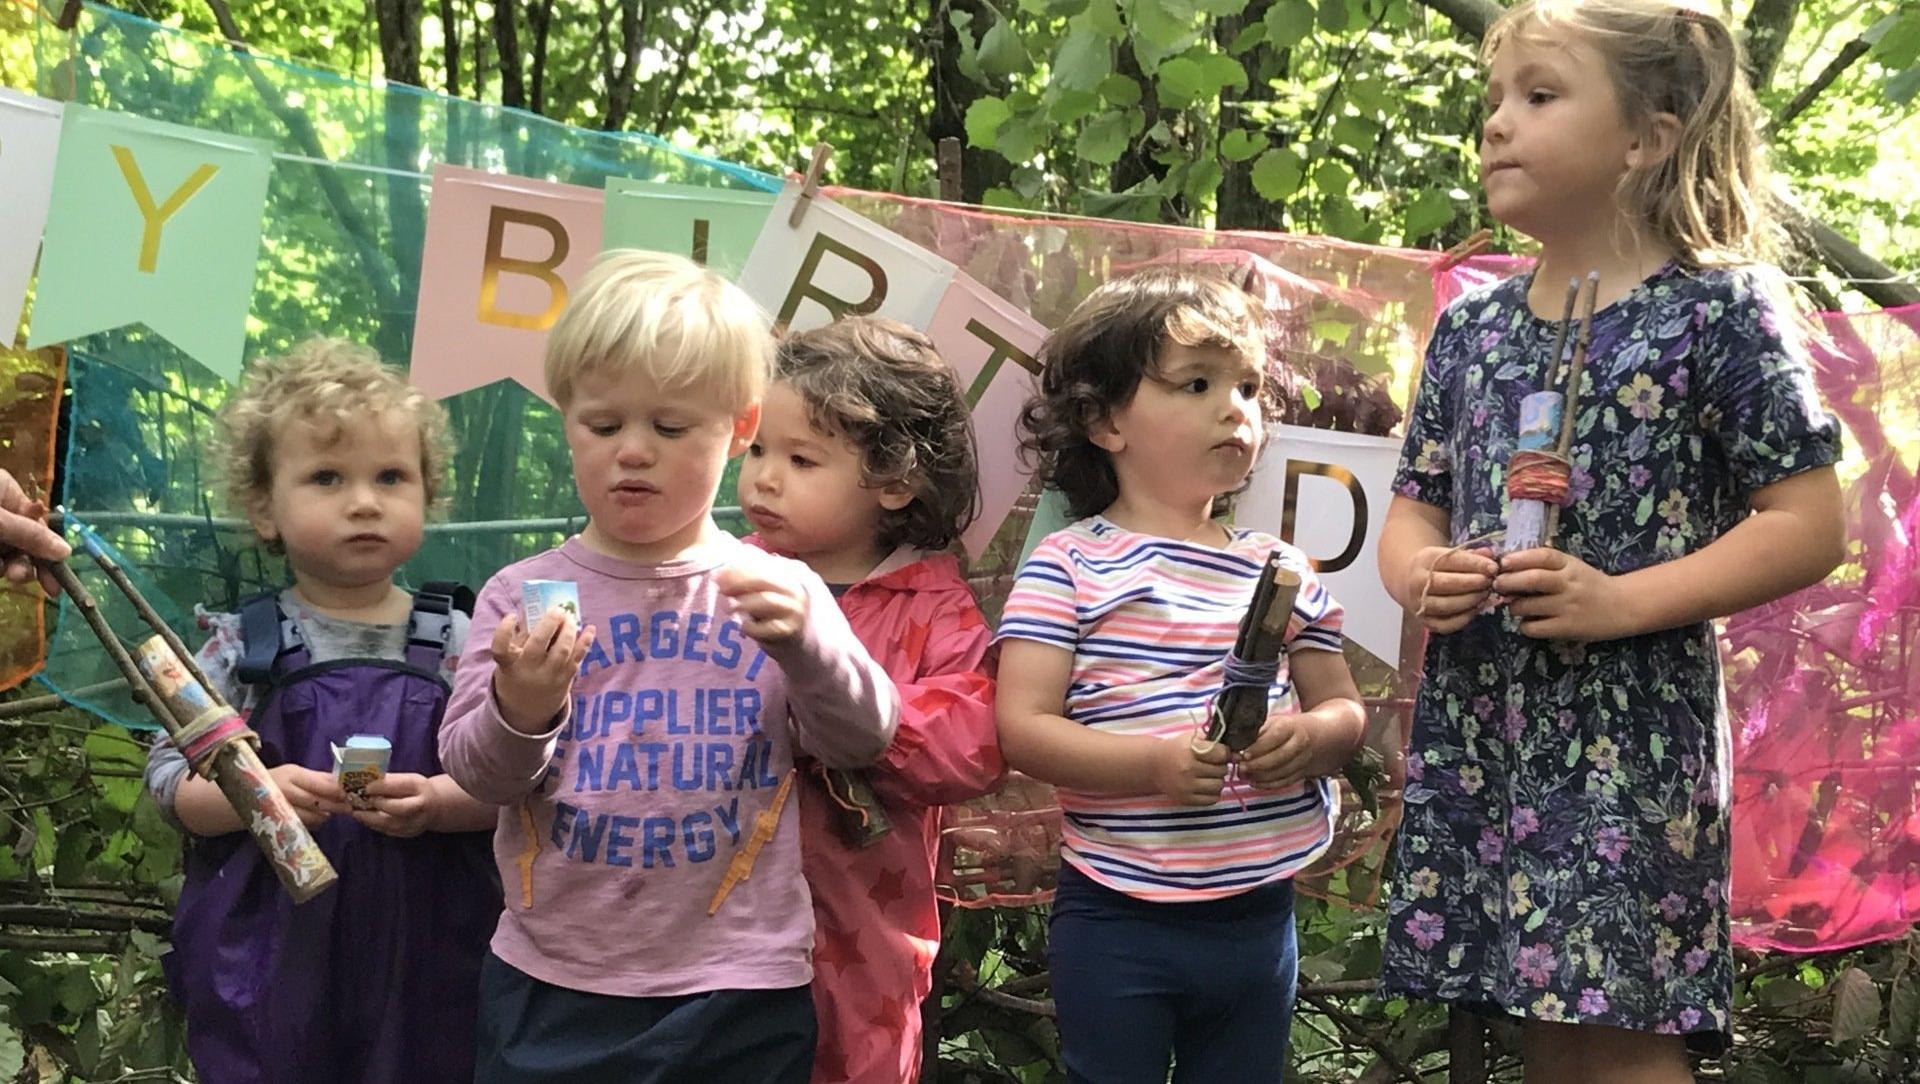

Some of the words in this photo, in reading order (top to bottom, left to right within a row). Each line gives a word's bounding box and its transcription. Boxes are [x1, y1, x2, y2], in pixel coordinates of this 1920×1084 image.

[110, 144, 220, 273] Y
[577, 609, 768, 682] ARGES
[574, 740, 779, 793] NATURAL
[550, 796, 741, 870] ENERGY
